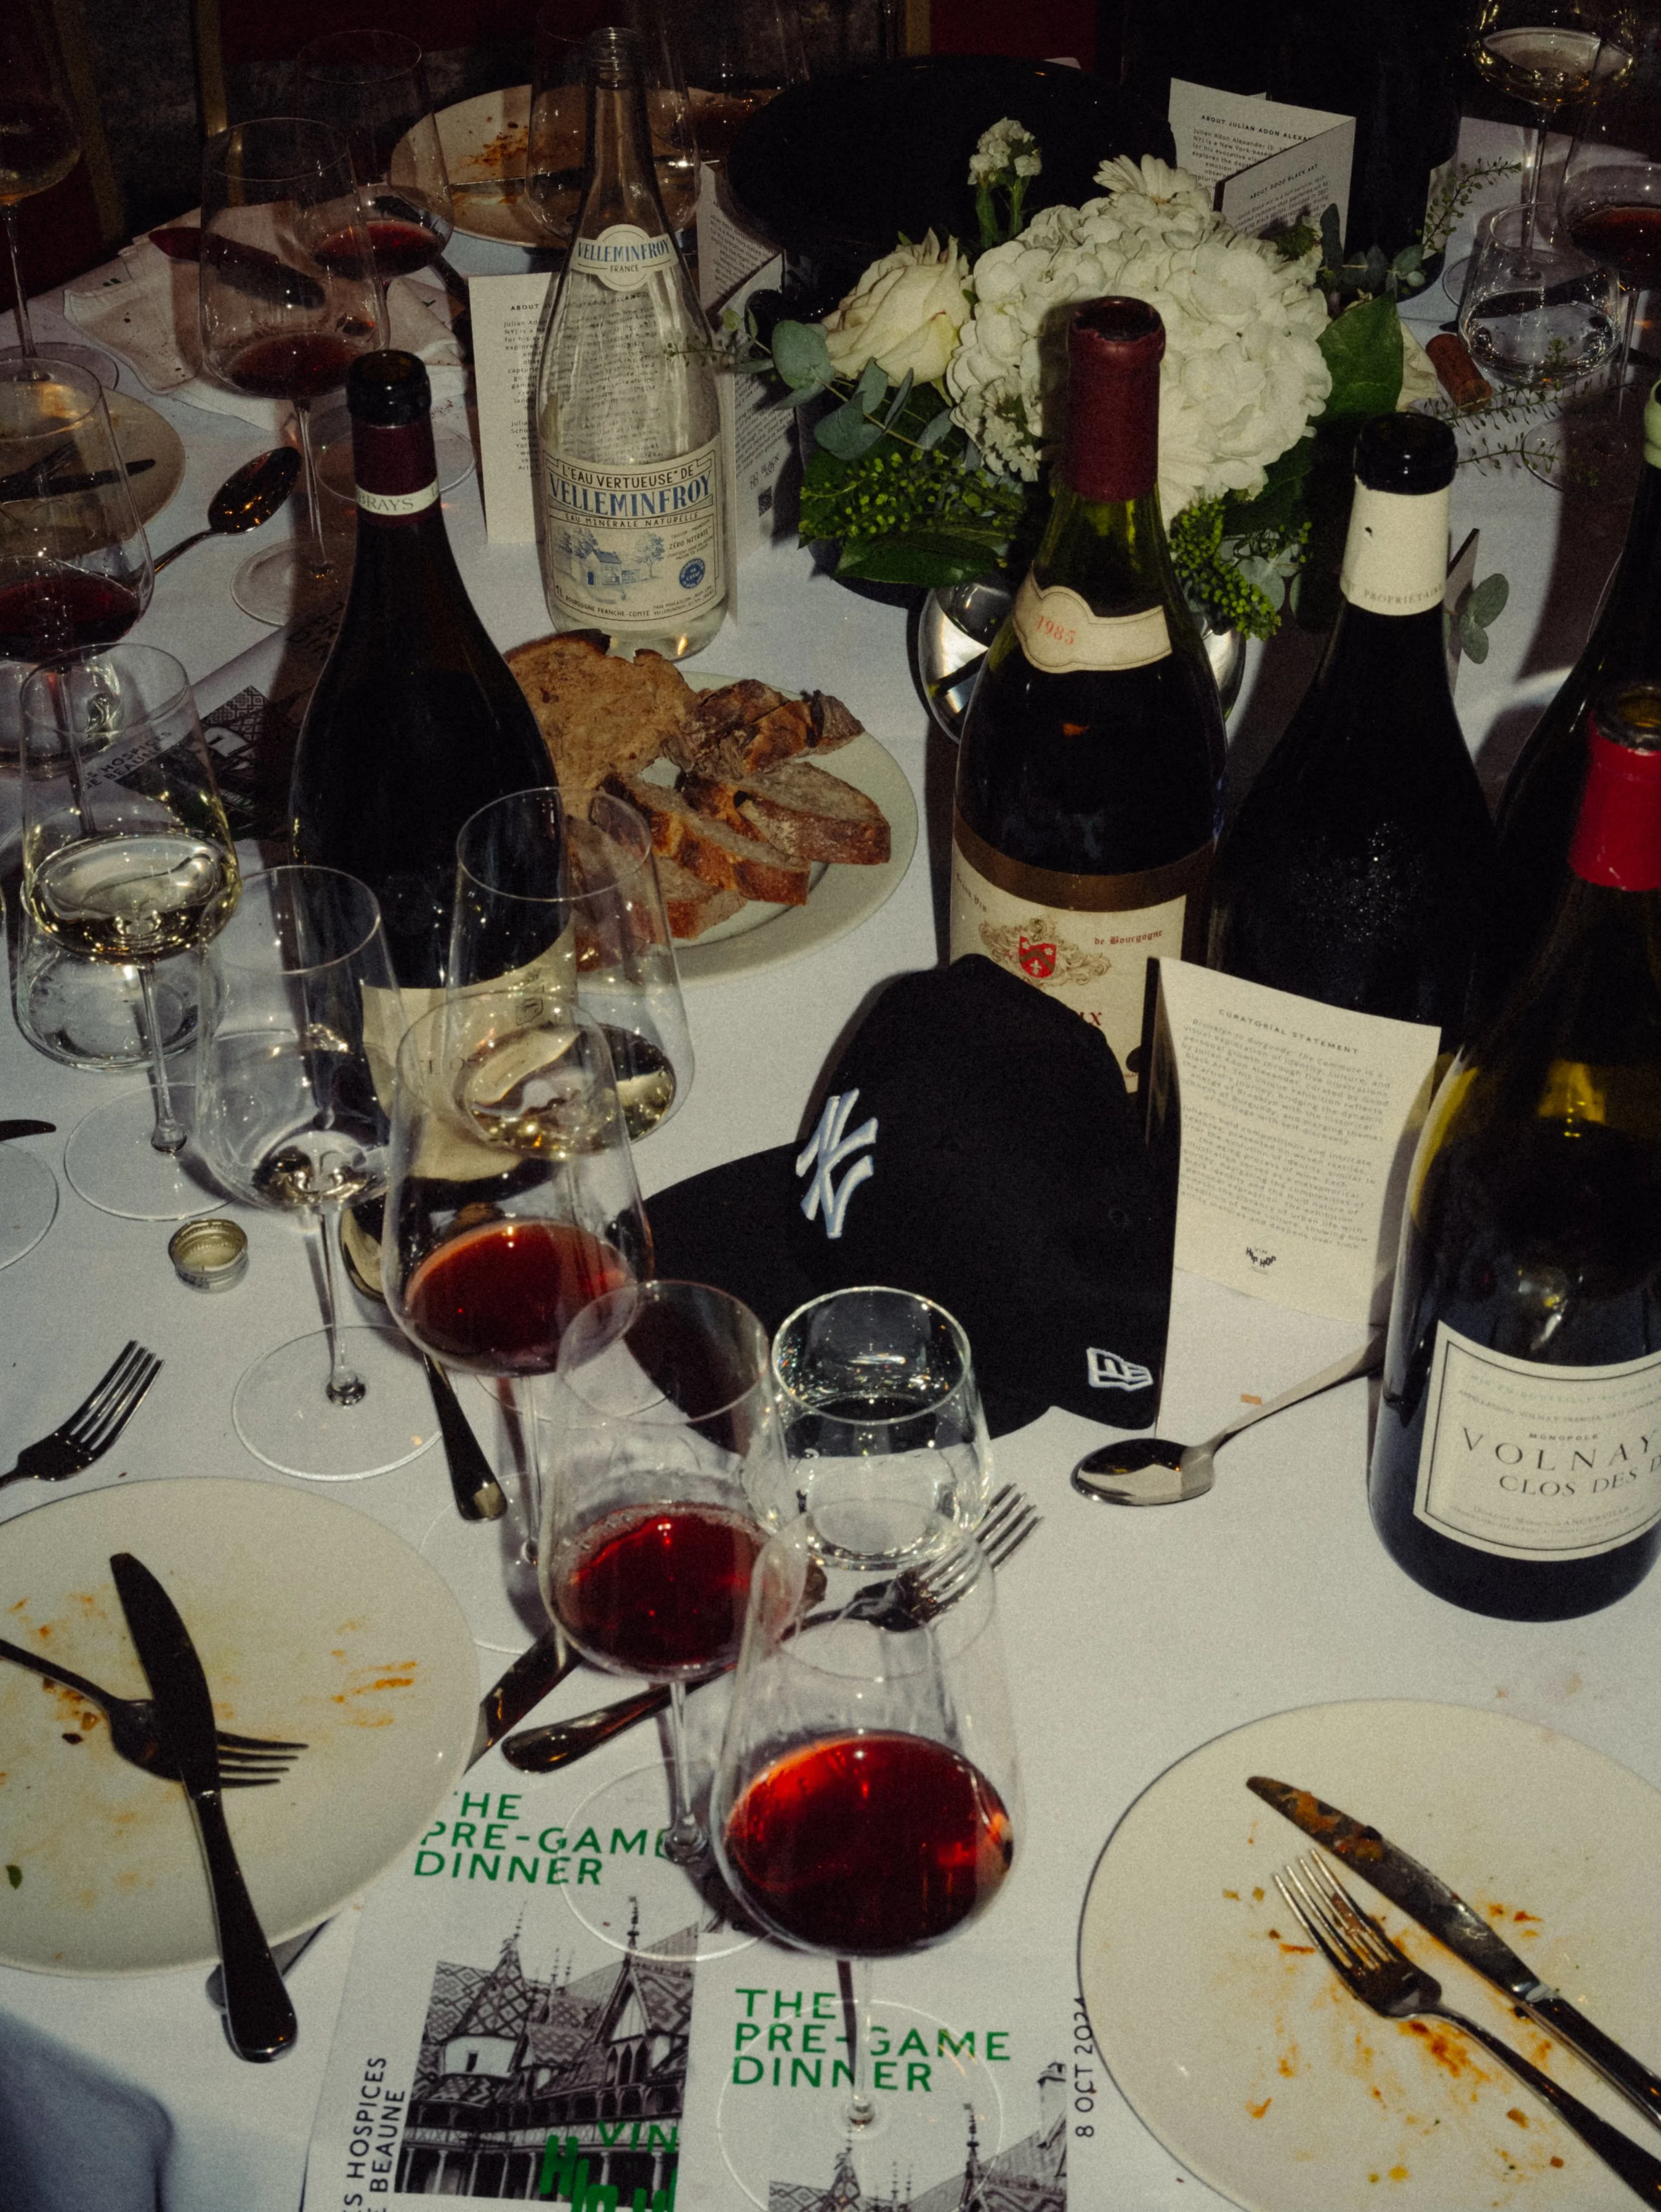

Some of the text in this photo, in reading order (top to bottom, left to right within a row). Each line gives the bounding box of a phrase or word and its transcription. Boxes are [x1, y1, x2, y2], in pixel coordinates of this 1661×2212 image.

[1193, 128, 1212, 137] Julian
[1232, 138, 1265, 149] Alexander
[1201, 115, 1226, 124] ABOUT
[1229, 122, 1255, 131] JULIAN
[1192, 151, 1219, 161] explores
[1215, 149, 1246, 160] evocative
[1250, 163, 1318, 199] ABOUT GOOD BLACK ART
[577, 238, 670, 262] VELLEMINFROY
[563, 464, 593, 485] L'EAU
[681, 465, 694, 480] DE
[549, 469, 712, 517] VELLEMINFROY
[565, 511, 698, 527] EAU MINÉRALE NATURELLE
[555, 585, 650, 617] 1L BOURGOGNE FRANCHE-COMTÉ
[1036, 616, 1076, 646] 1985
[973, 896, 987, 912] Vin
[1094, 937, 1105, 945] de
[1109, 929, 1163, 946] Bourgogne
[1219, 1008, 1359, 1056] CURATORIAL STATEMENT
[1260, 1255, 1276, 1268] HOP
[1462, 1426, 1657, 1471] VOLNAY
[1529, 1432, 1599, 1441] MONOPOLE
[1499, 1466, 1638, 1497] CLOS DES
[454, 1790, 522, 1820] HE
[414, 1851, 603, 1886] DINNER
[735, 1987, 837, 2020] THE
[735, 2022, 1011, 2062] PRE-GAME
[732, 2055, 933, 2093] DINNER
[1074, 2064, 1094, 2113] OCT
[346, 2057, 387, 2179] HOSPICES
[1075, 2125, 1094, 2138] 8
[369, 2090, 405, 2192] BEAUNE
[598, 2120, 678, 2154] VIN
